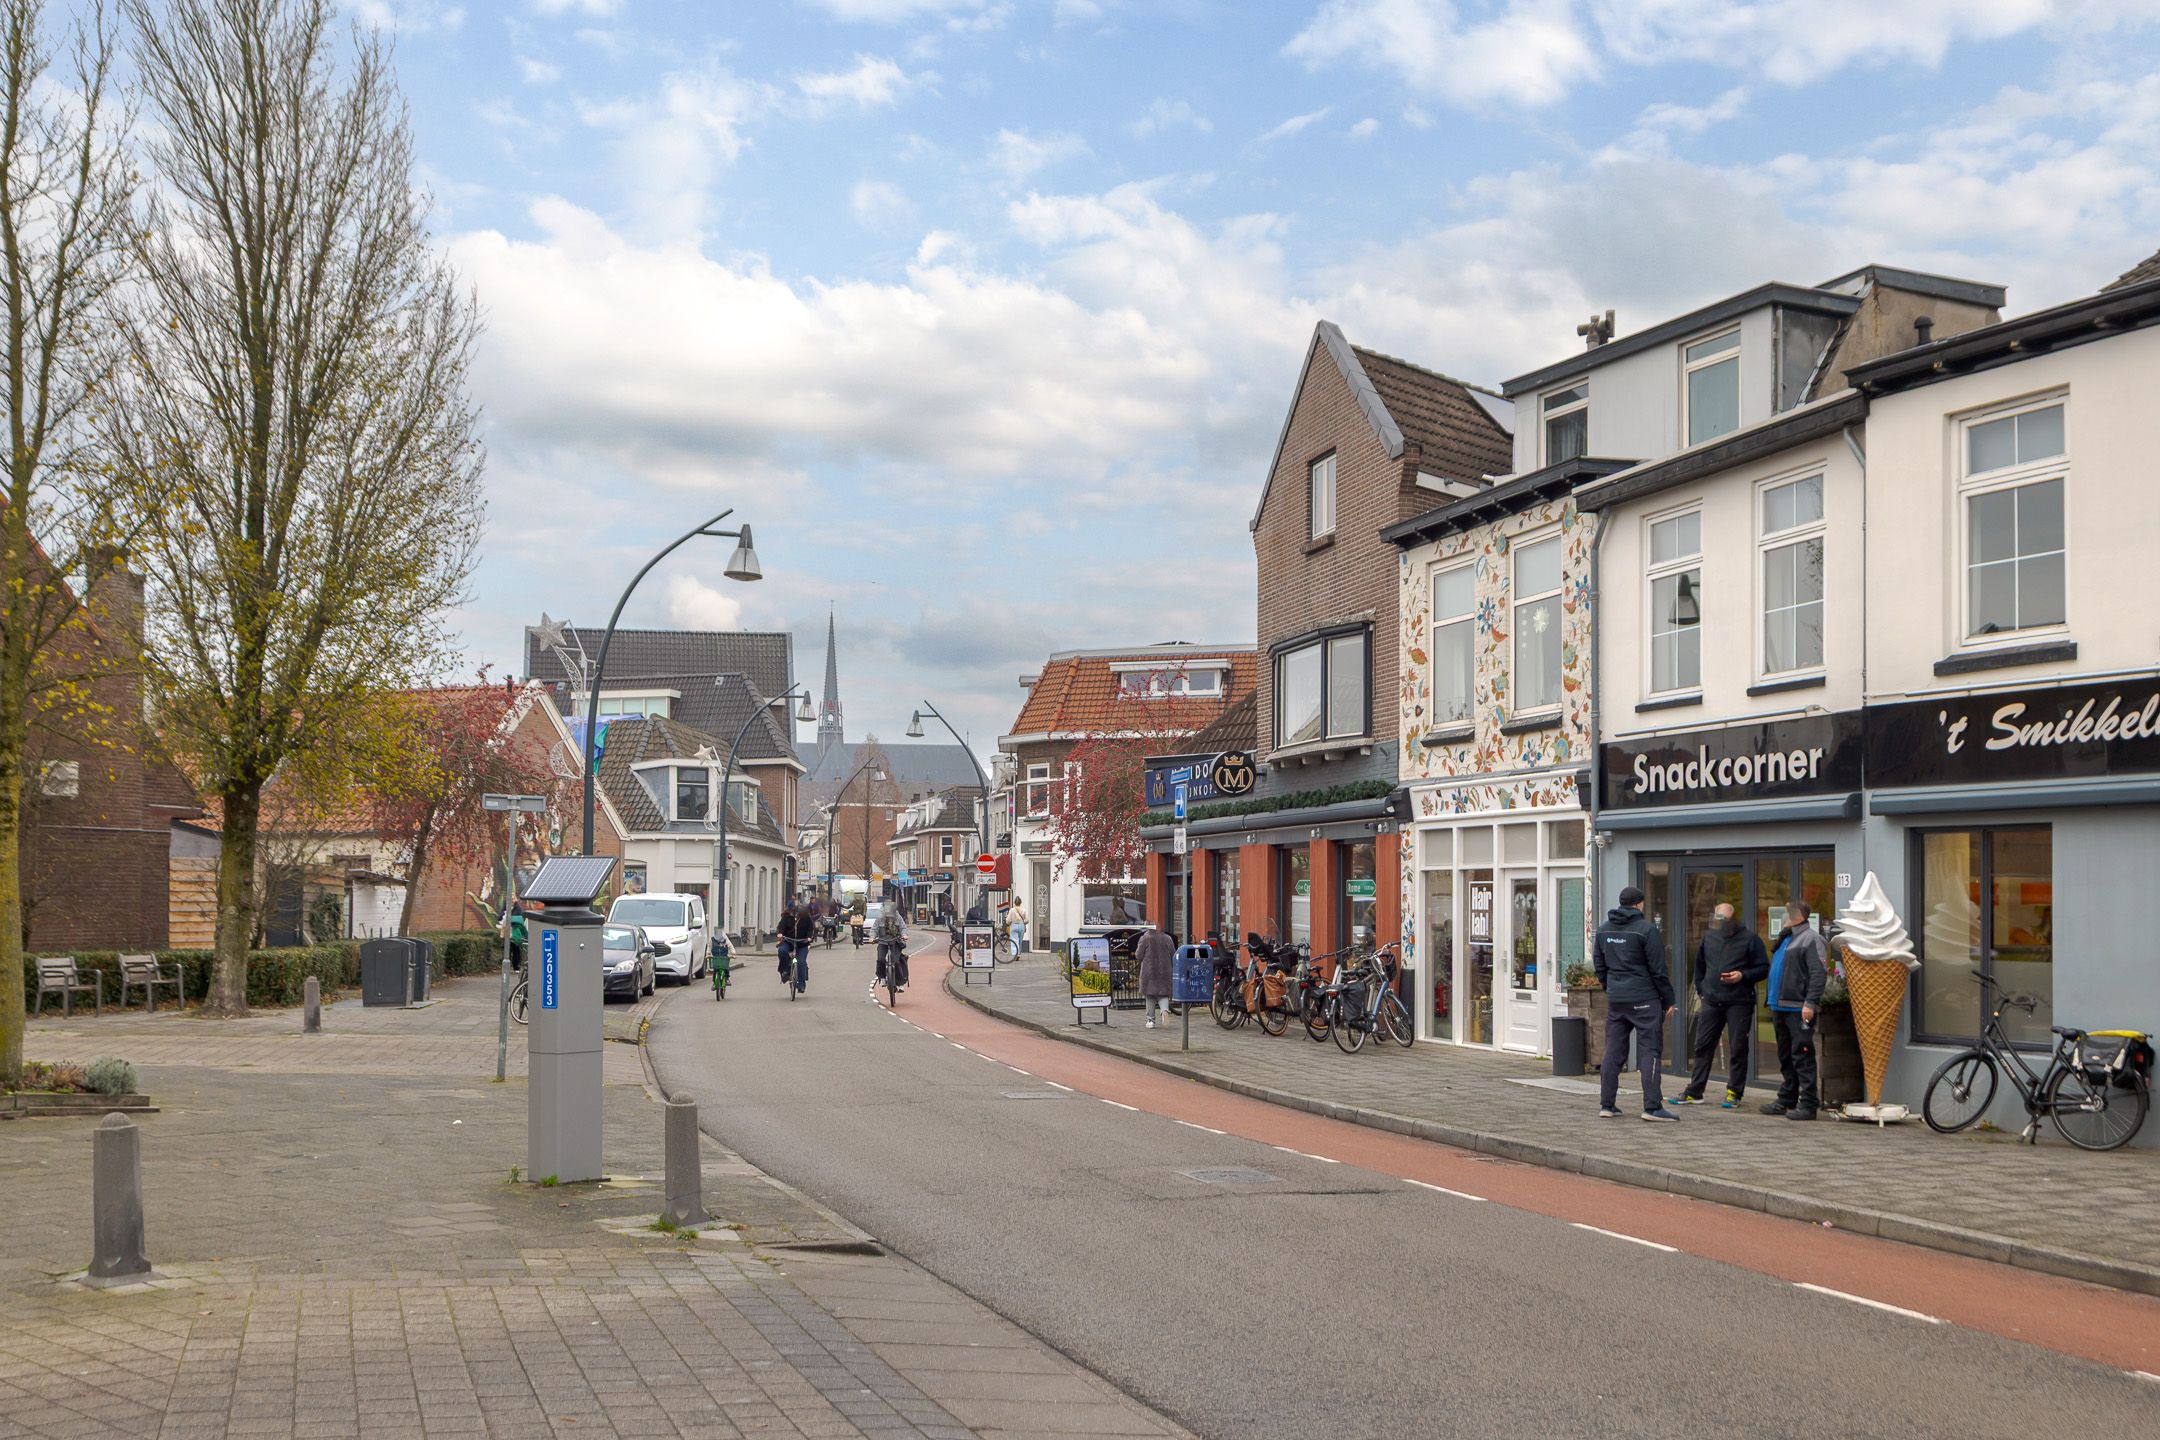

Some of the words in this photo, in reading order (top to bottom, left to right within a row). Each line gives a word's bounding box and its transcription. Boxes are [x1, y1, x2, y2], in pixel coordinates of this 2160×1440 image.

[1938, 710, 1968, 754] 't
[1985, 693, 2160, 750] Smikkel
[1634, 744, 1823, 794] Snackcorner
[1838, 875, 1849, 887] 113
[1471, 886, 1492, 910] Hair
[1471, 912, 1489, 936] lab!
